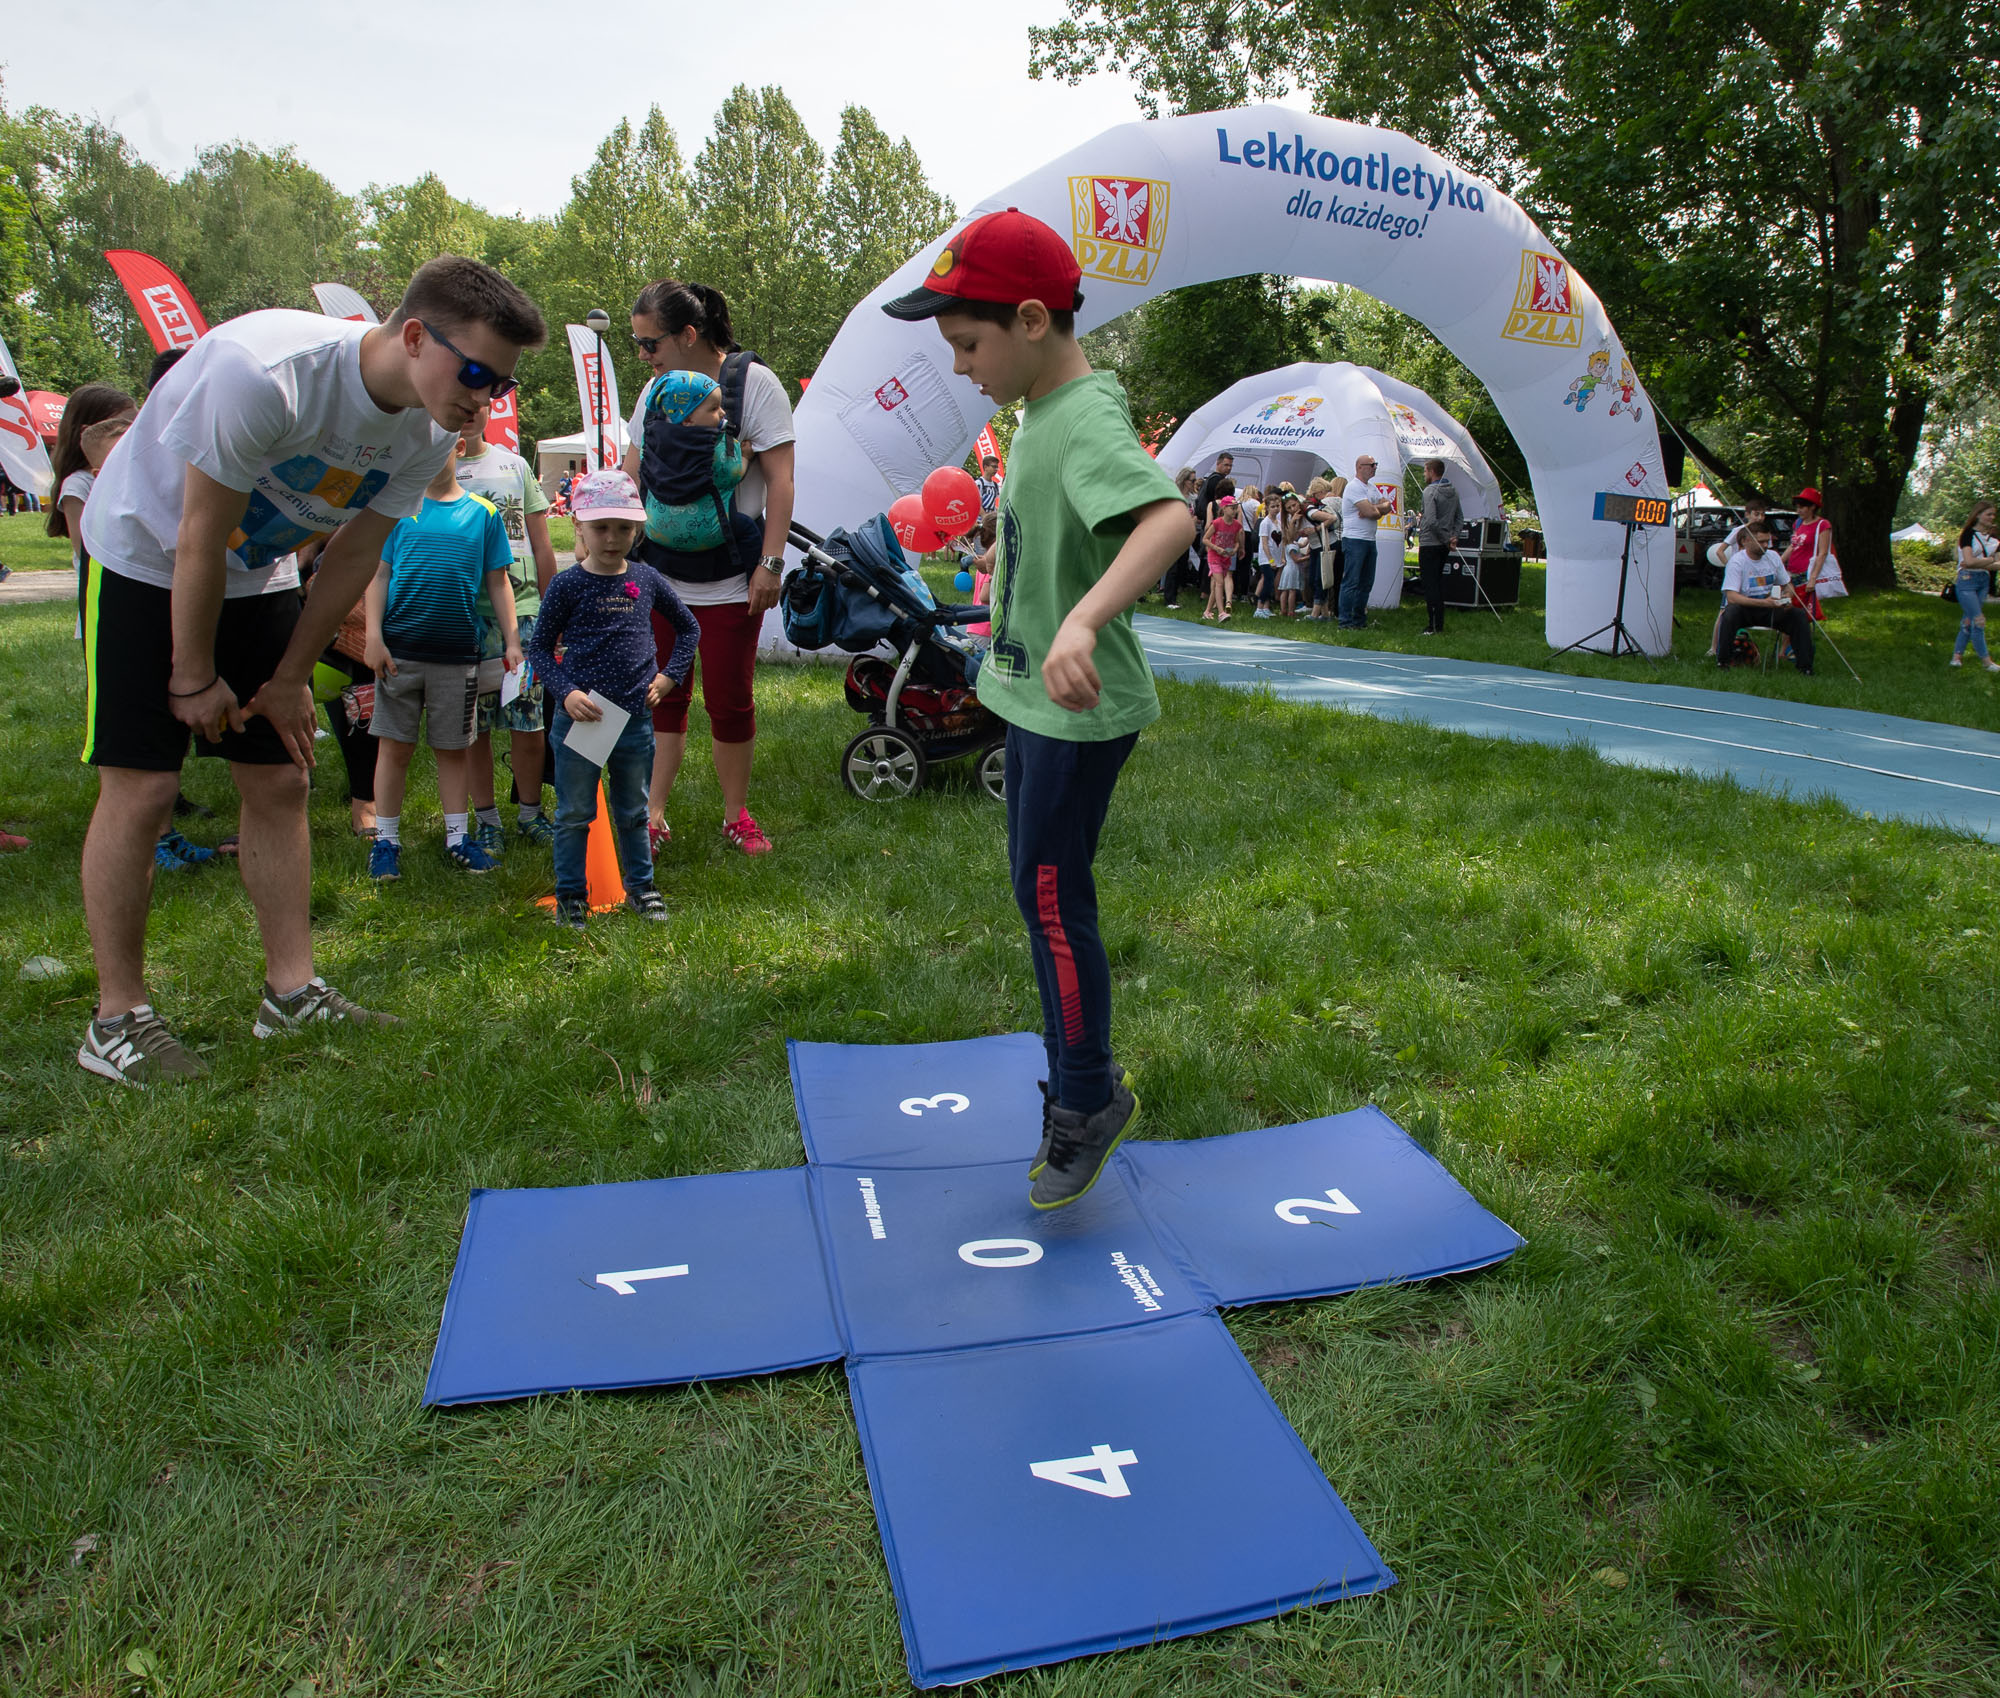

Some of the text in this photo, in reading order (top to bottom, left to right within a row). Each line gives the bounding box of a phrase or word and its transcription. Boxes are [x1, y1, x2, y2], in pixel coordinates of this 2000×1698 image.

[1217, 128, 1485, 213] Lekkoatletyka
[1286, 189, 1429, 240] dla każdego!
[1078, 240, 1148, 281] PZLA
[1507, 313, 1577, 343] PZLA
[895, 410, 913, 435] Sportu
[903, 404, 934, 448] Ministerstwo
[1233, 423, 1325, 439] Lekkoatletyka
[1250, 436, 1262, 444] dla
[937, 512, 968, 525] ORLEN
[1634, 499, 1667, 524] 0.00
[904, 526, 915, 548] LEN
[899, 1092, 970, 1116] 3
[857, 1177, 887, 1240] www.legend.pl
[1274, 1188, 1362, 1224] 2
[958, 1238, 1044, 1268] 0
[596, 1264, 689, 1295] 1
[1111, 1251, 1162, 1312] Lekkoatletyka
[1029, 1443, 1139, 1498] 4
